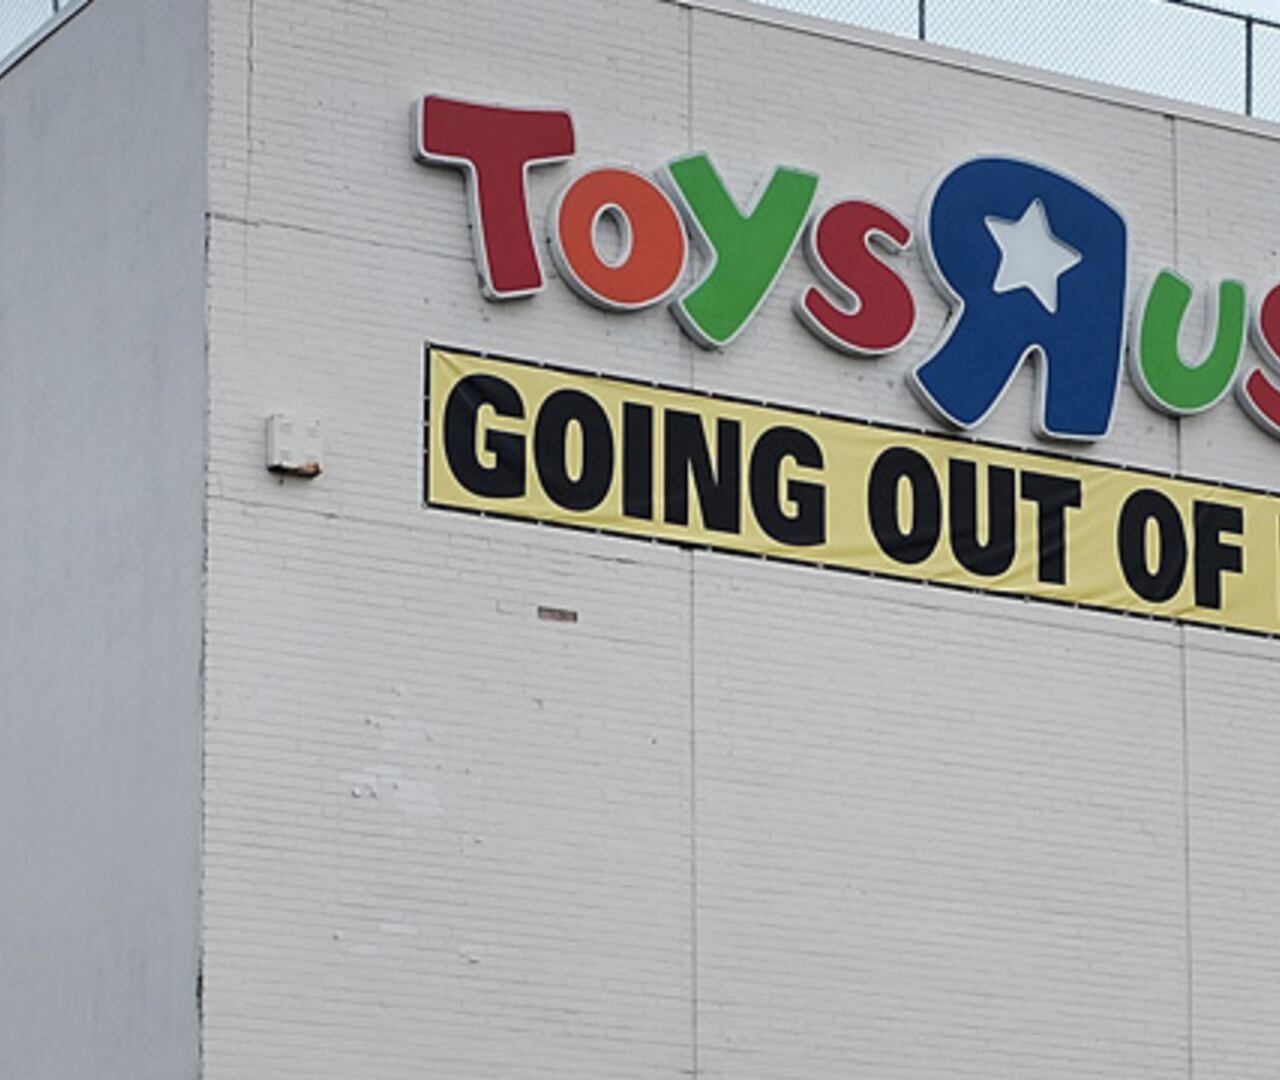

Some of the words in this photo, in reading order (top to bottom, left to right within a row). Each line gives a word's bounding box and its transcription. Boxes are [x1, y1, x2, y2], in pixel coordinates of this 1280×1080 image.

[442, 373, 828, 547] GOING
[867, 445, 1083, 586] OUT
[1117, 487, 1244, 610] OF
